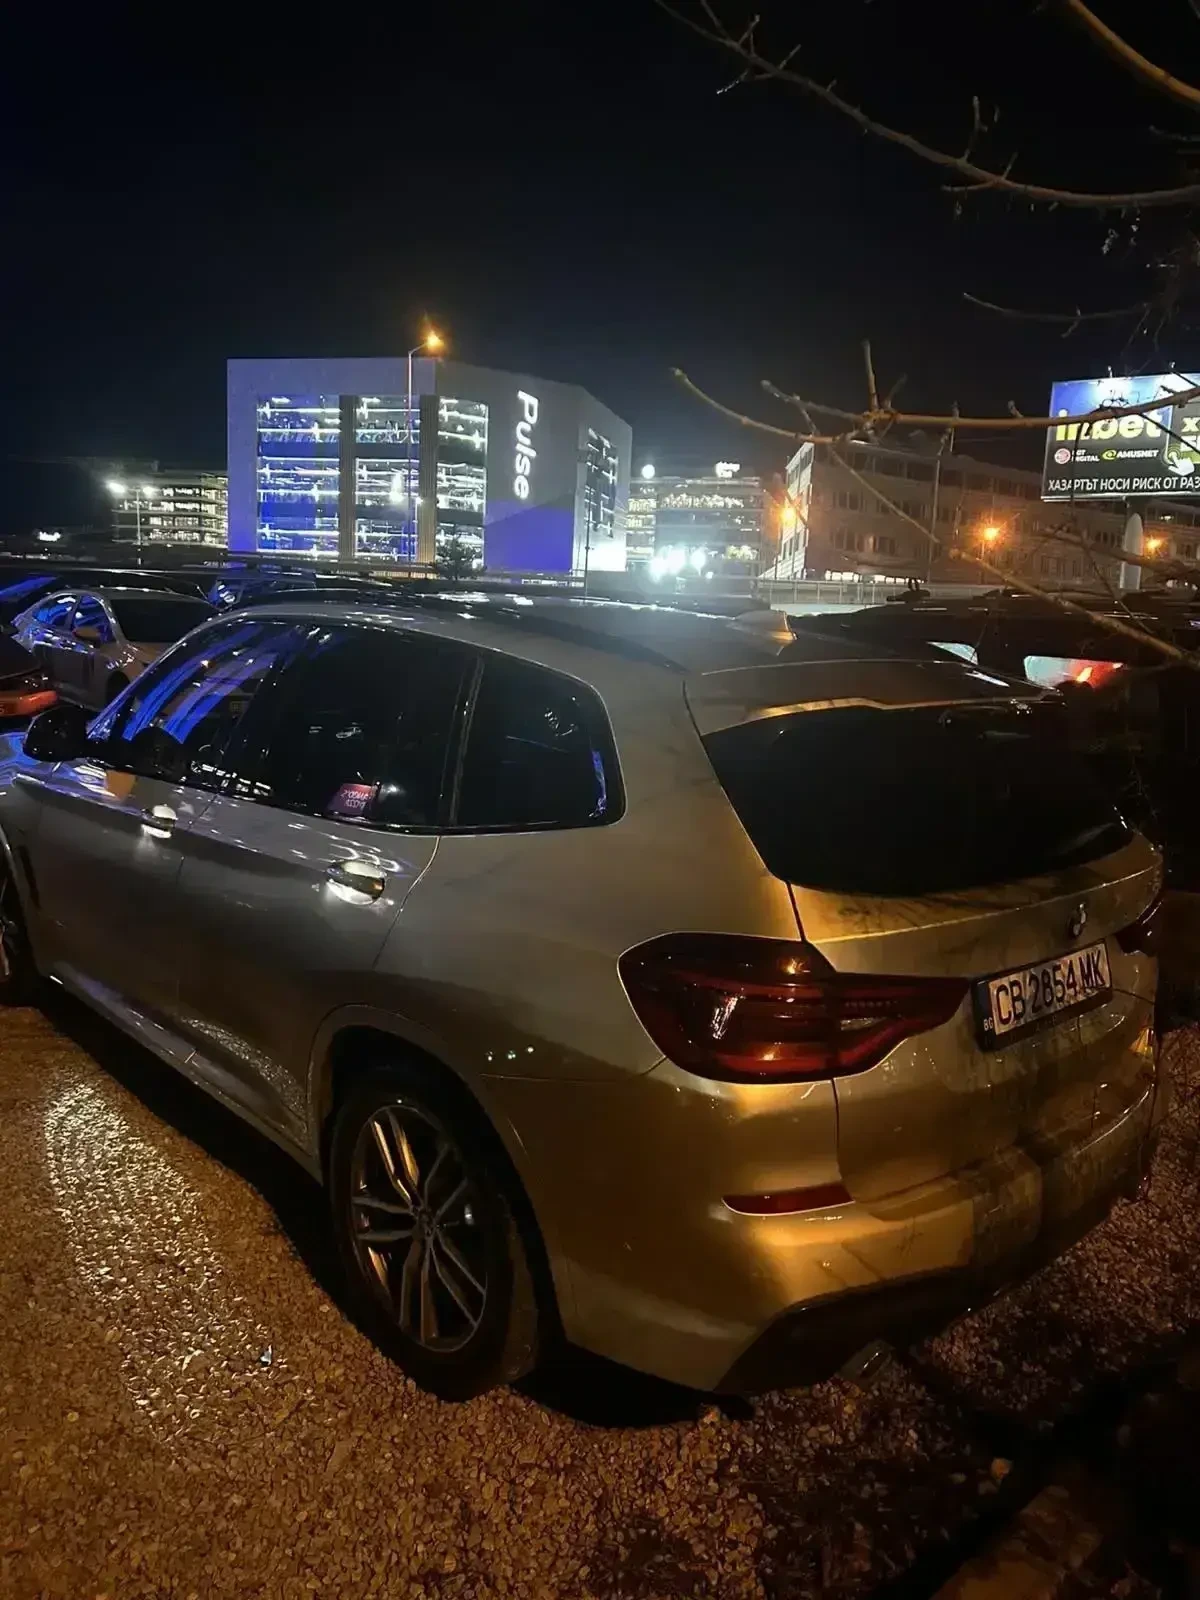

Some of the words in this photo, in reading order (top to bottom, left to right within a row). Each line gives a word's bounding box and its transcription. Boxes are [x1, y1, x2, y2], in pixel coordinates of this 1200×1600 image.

[513, 390, 539, 500] Pulse
[1100, 478, 1130, 490] НОСИ
[1132, 477, 1162, 490] РИСК
[1163, 477, 1178, 489] ОТ
